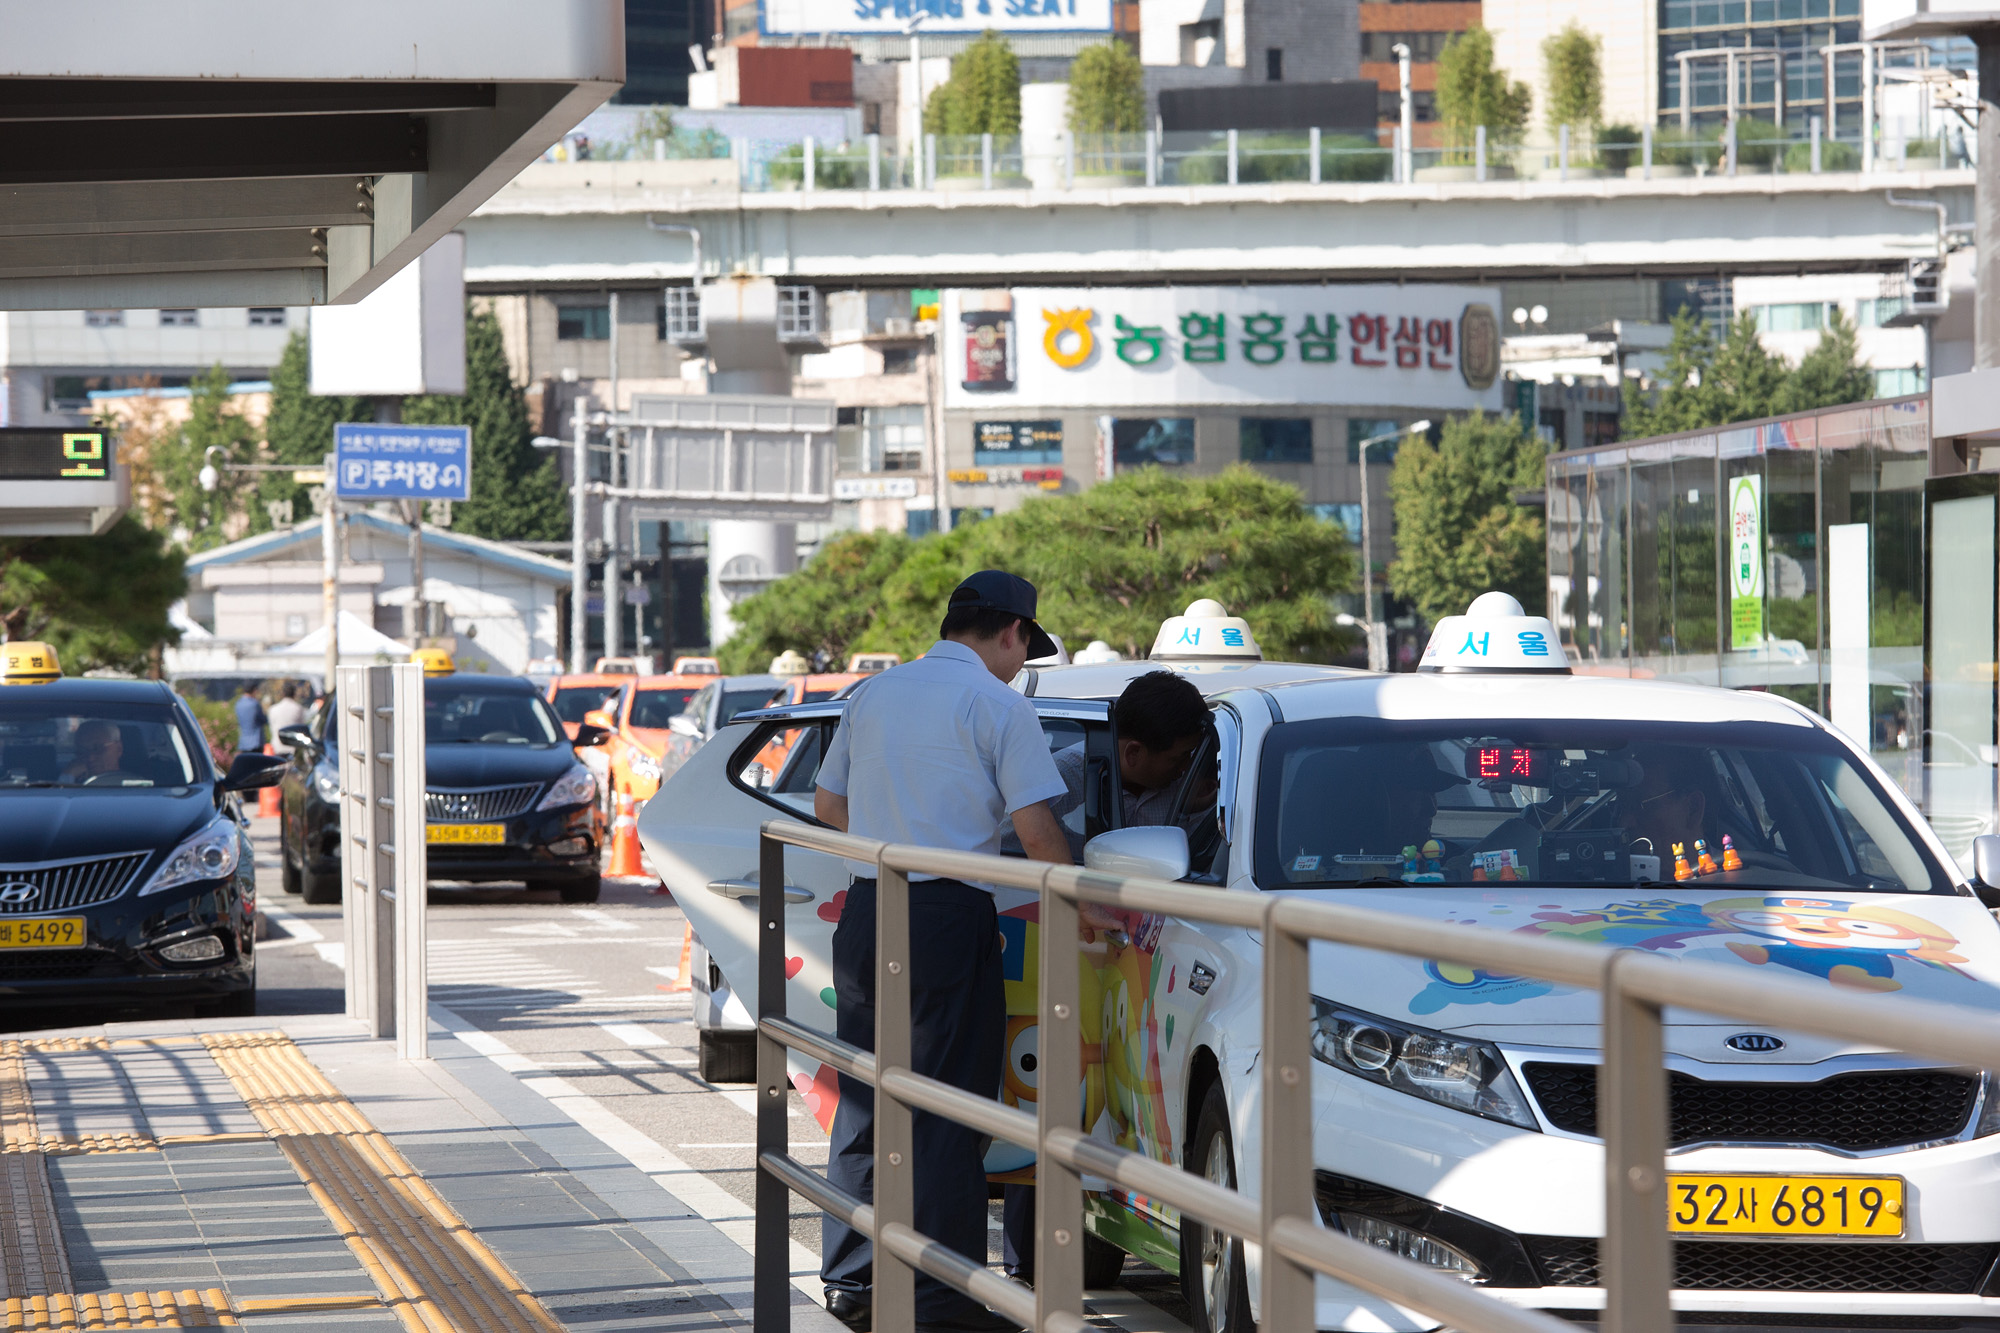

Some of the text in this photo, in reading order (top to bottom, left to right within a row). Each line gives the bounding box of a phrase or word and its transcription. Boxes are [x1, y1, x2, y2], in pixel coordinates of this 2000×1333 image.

[1114, 310, 1341, 365] 농협홍삼
[1349, 312, 1454, 370] 한삼인
[372, 460, 439, 491] 주차장
[1176, 627, 1245, 647] 서울
[1457, 631, 1549, 656] 서울
[19, 922, 75, 943] 5499
[1734, 1036, 1777, 1049] KIA
[1675, 1183, 1884, 1228] 32사 6819
